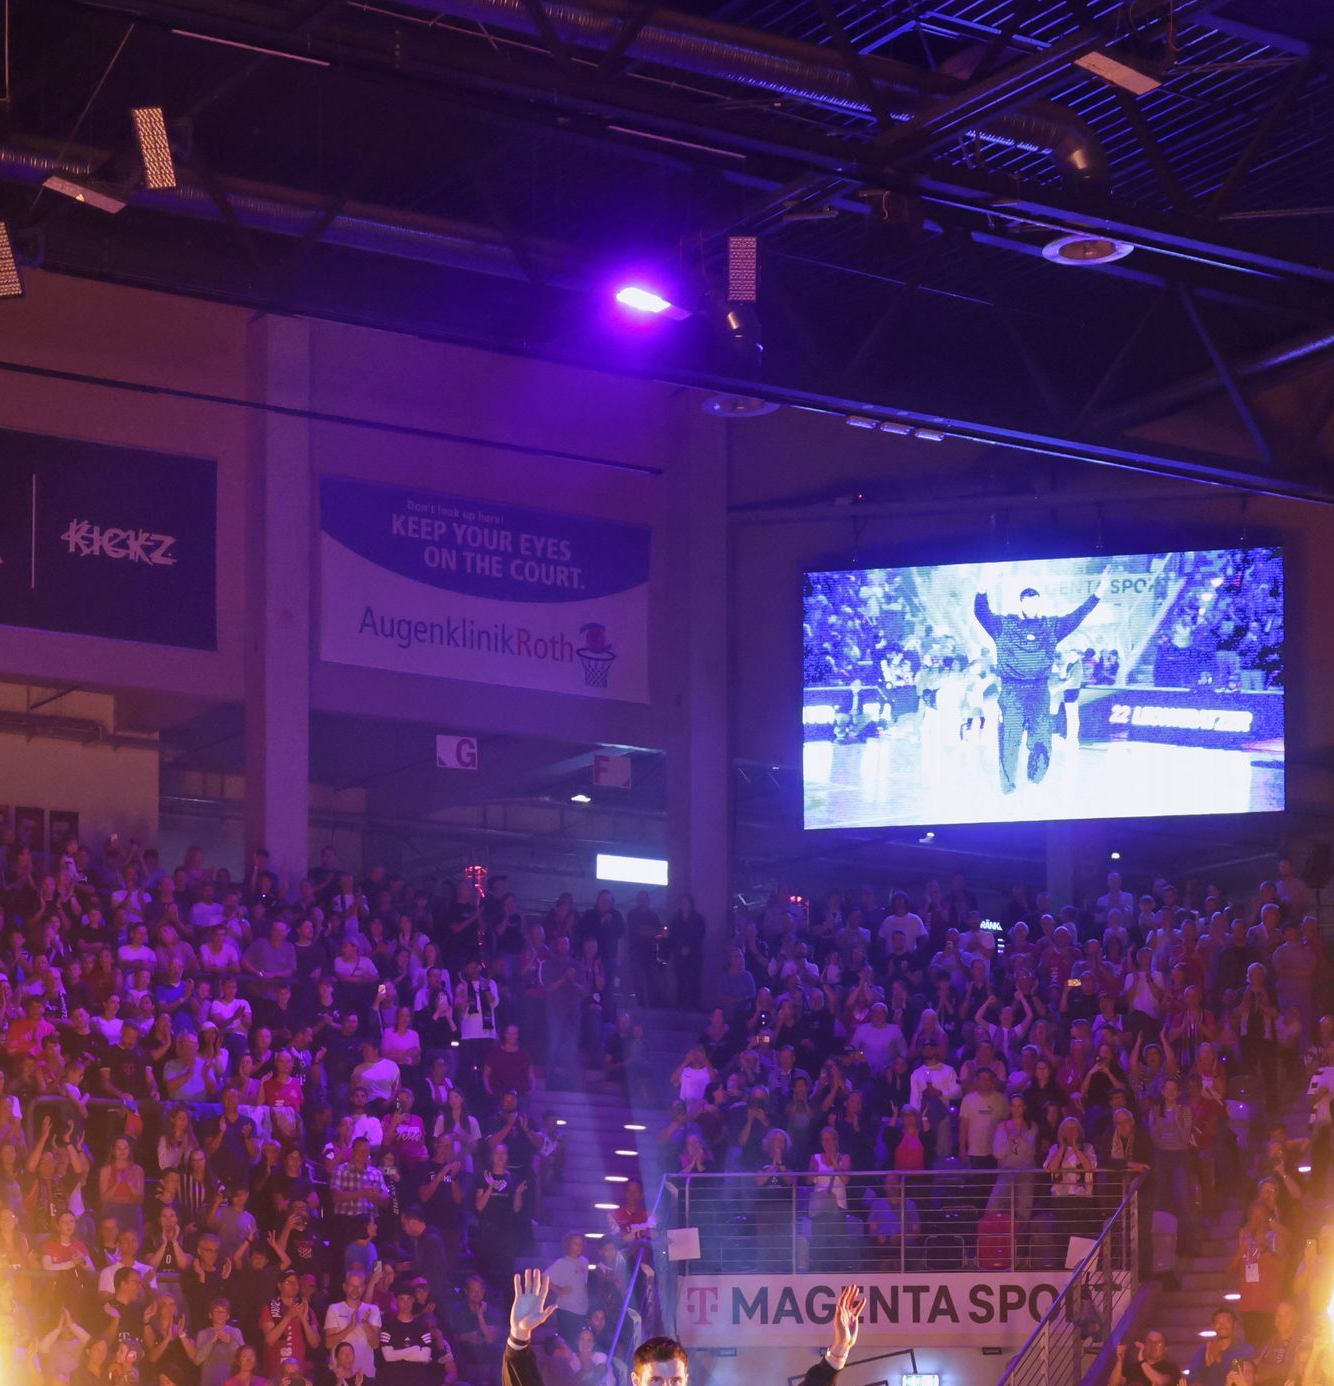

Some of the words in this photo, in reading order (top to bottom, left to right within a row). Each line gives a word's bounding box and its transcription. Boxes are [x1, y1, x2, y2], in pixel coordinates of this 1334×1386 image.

[391, 513, 448, 543] KEEP
[452, 521, 512, 554] YOUR
[519, 532, 572, 562] EYES
[424, 546, 456, 571] ON
[464, 552, 503, 579] THE
[509, 557, 586, 591] COURT.
[359, 606, 575, 665] AugenklinikRoth
[455, 738, 476, 769] G
[594, 755, 610, 784] F
[968, 1283, 1122, 1324] SPO
